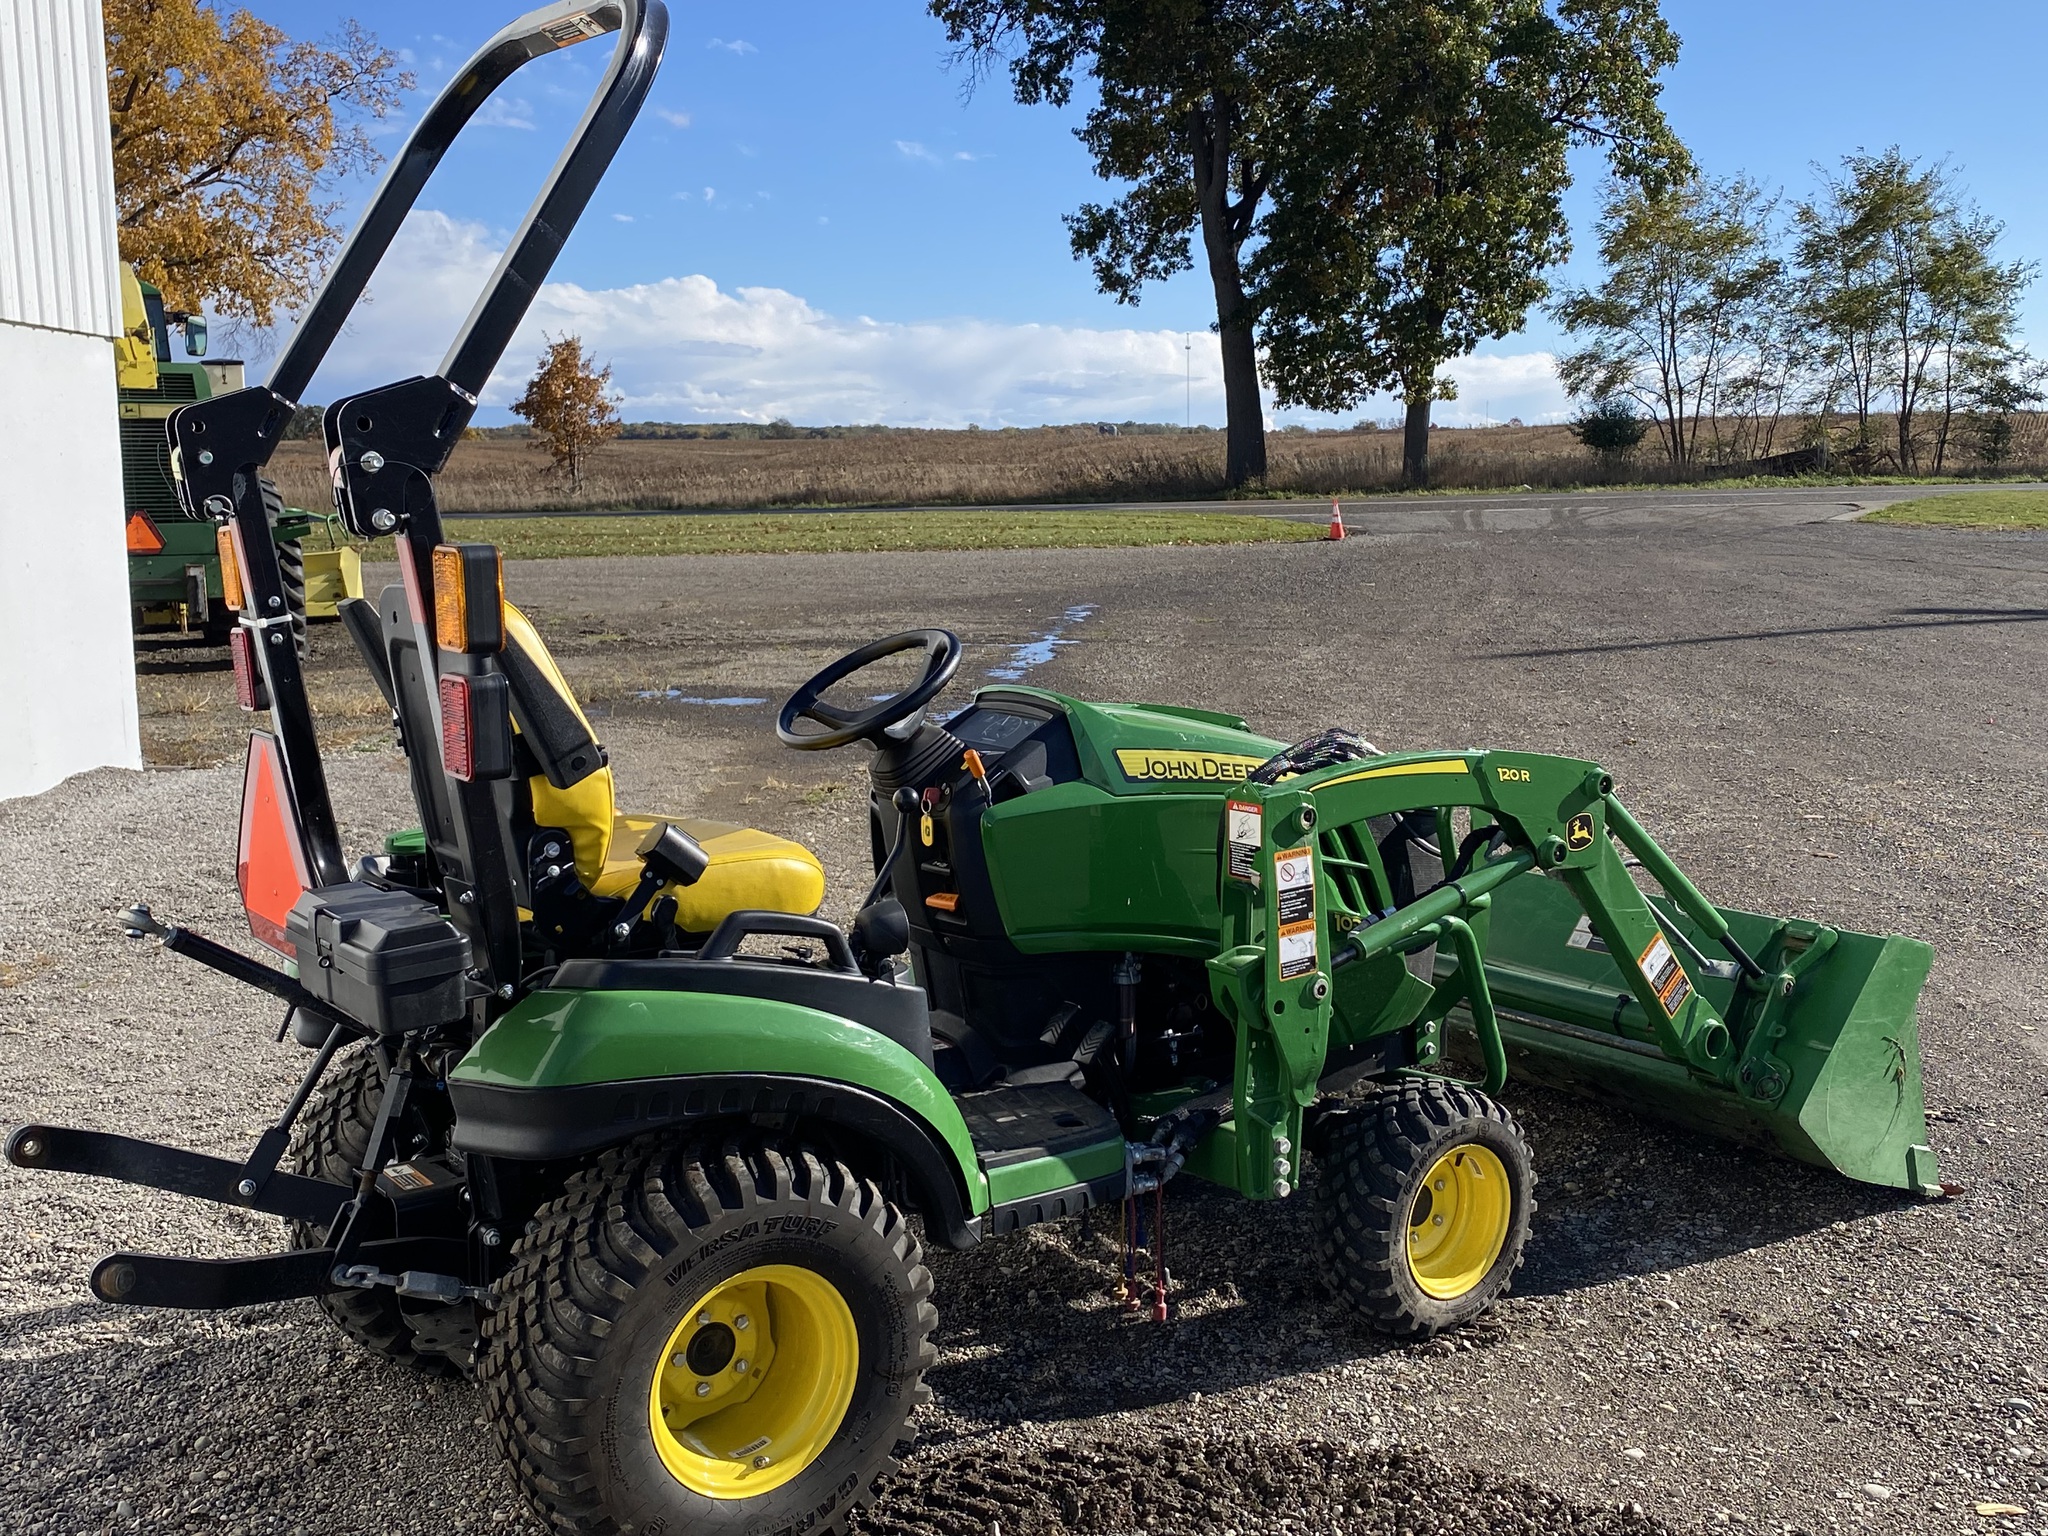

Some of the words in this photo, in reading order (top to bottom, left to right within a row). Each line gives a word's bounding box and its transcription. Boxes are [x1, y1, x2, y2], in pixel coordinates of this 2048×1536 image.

[1139, 757, 1198, 778] JOHN
[1202, 758, 1261, 780] DEER
[1238, 804, 1259, 814] DANGER
[663, 1220, 760, 1288] VERSA
[764, 1213, 841, 1240] TURF
